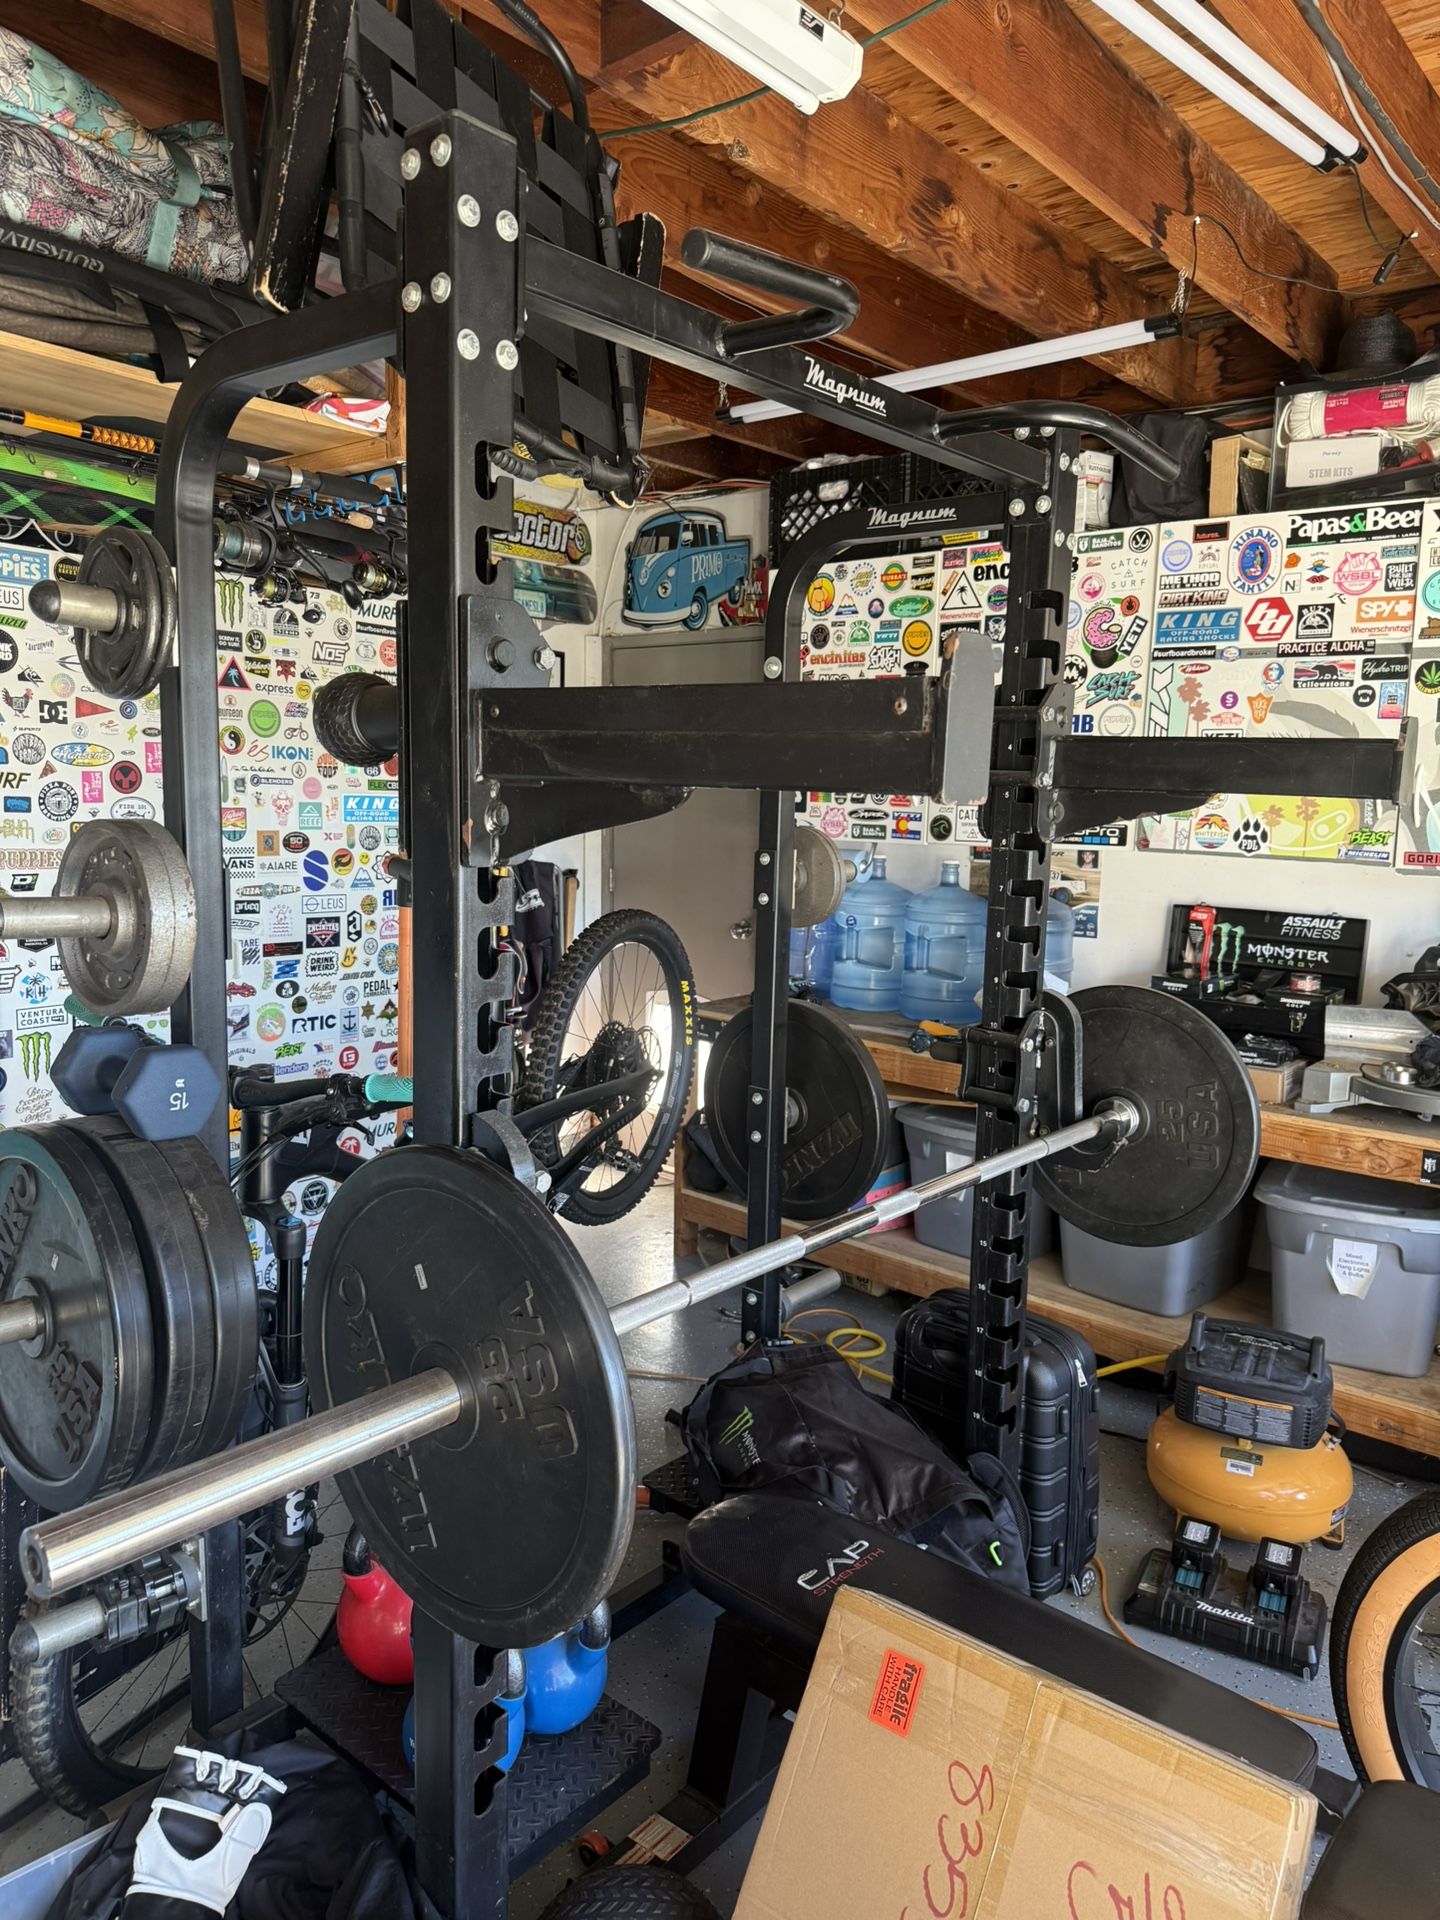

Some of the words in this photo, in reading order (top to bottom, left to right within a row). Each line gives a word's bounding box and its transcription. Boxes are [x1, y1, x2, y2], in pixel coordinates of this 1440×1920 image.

[0, 227, 105, 273] QUIKSILV
[804, 356, 887, 416] Magnum
[1309, 468, 1332, 479] STEM
[1333, 466, 1353, 477] KITS
[867, 507, 957, 529] Magnum
[1232, 528, 1279, 554] HINANO
[691, 551, 723, 584] PRIMO
[1110, 557, 1148, 571] CATCH
[1111, 578, 1146, 590] SURF
[1160, 572, 1221, 586] METHOD
[1337, 571, 1380, 583] WSBL
[1160, 591, 1191, 605] DIRT
[1193, 588, 1229, 603] KING
[1161, 611, 1238, 628] KING
[1119, 619, 1148, 656] YETI
[1160, 635, 1196, 643] RACING
[1198, 633, 1236, 642] SHOCKS
[1171, 629, 1220, 637] OFF-ROAD
[312, 640, 350, 663] NOS
[1153, 648, 1216, 658] #surfboardbroker
[1279, 641, 1328, 654] PRACTICE
[1330, 640, 1365, 652] ALOHA
[810, 650, 866, 666] encinitas
[255, 682, 294, 697] express
[1297, 680, 1351, 689] Yellowstone
[271, 745, 310, 761] IKON
[366, 766, 380, 777] 66
[260, 777, 294, 785] BLENDERS
[346, 796, 399, 810] KING
[299, 817, 321, 827] REEF
[1241, 838, 1259, 851] PDL
[1350, 830, 1393, 847] BEAST
[1347, 850, 1389, 859] MICHELIN
[223, 856, 255, 870] VANS
[1283, 915, 1347, 930] ASSAULT
[1280, 926, 1342, 941] FITNESS
[310, 956, 334, 966] DRINK
[1247, 943, 1330, 964] MONSTER
[310, 963, 336, 972] WEIRD
[1256, 956, 1316, 969] ENERGY
[363, 979, 391, 991] PEDAL
[20, 1007, 65, 1019] VENTURA
[680, 980, 694, 1047] MAXXIS
[20, 1016, 50, 1027] COAST
[291, 1014, 337, 1035] RTIC
[274, 1063, 309, 1075] lenders
[170, 1090, 190, 1110] 15
[1153, 1098, 1185, 1145] 25
[1185, 1080, 1222, 1172] USA
[477, 1335, 526, 1423] 25
[504, 1280, 579, 1463] USA
[54, 1360, 104, 1465] USA
[741, 1430, 762, 1465] MONSTE
[884, 1656, 898, 1685] WITH
[884, 1666, 903, 1713] HANDLE
[889, 1661, 918, 1726] fragile
[876, 1685, 890, 1718] CARE
